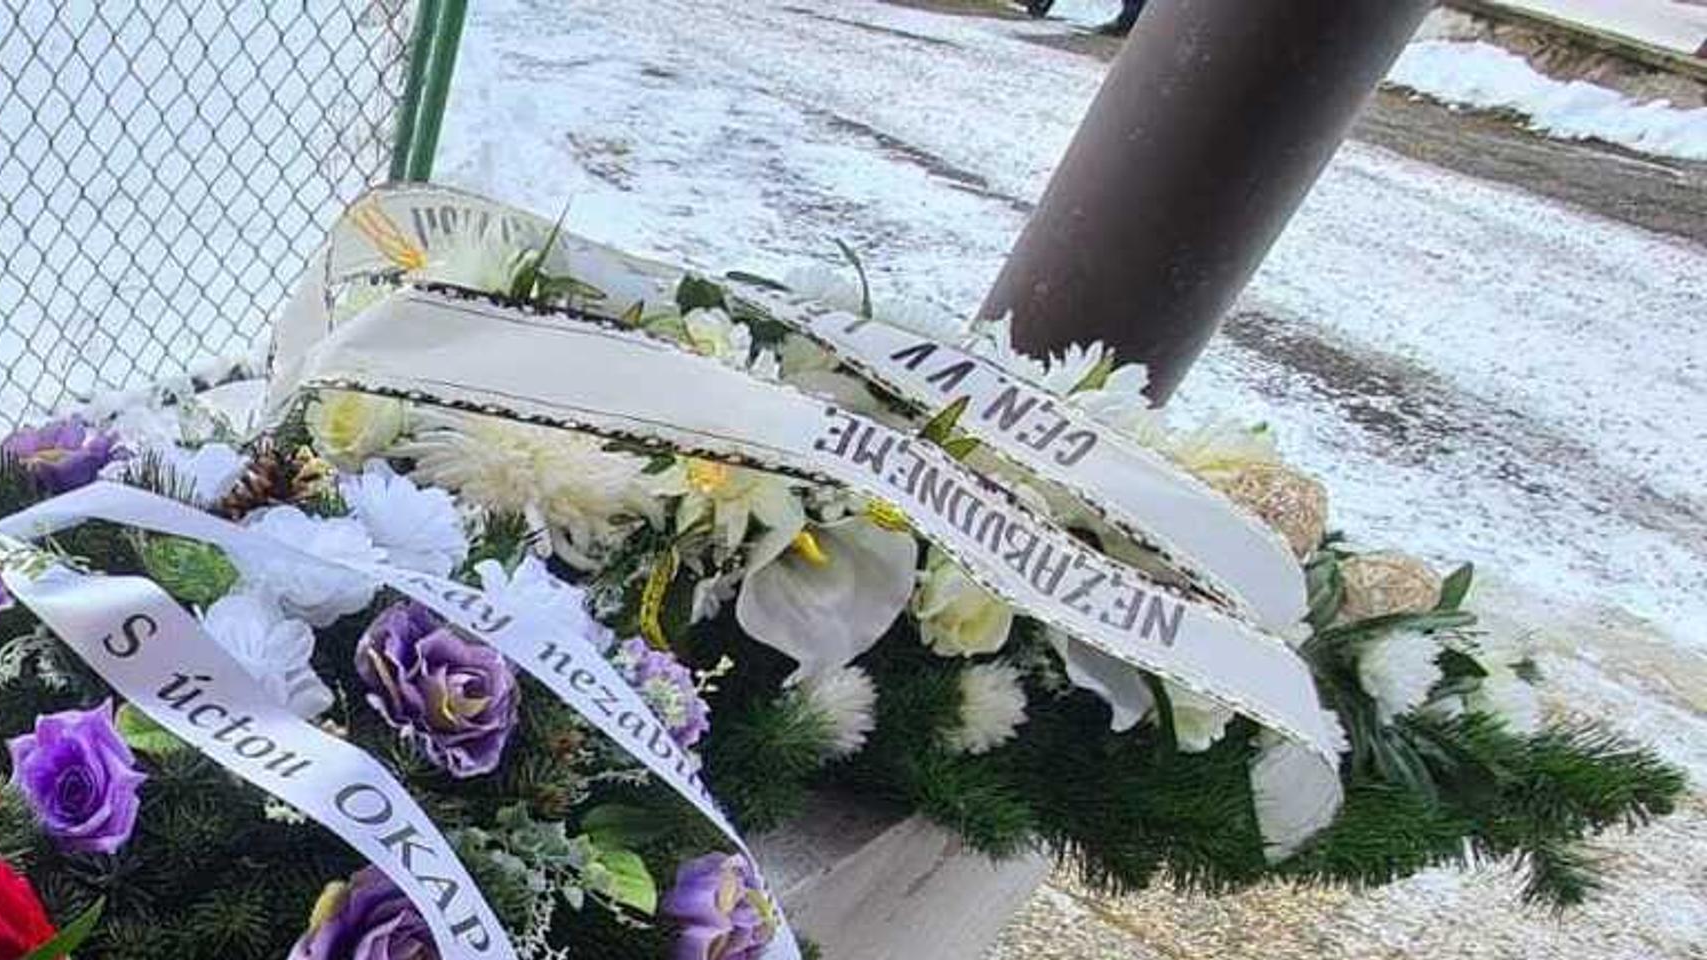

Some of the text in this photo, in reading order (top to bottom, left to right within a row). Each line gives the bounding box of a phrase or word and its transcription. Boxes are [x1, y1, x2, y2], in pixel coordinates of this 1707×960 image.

[813, 405, 1186, 647] NEZABUDNEME
[102, 613, 158, 658] S
[156, 671, 312, 778] úctou
[333, 782, 492, 952] OKAP
